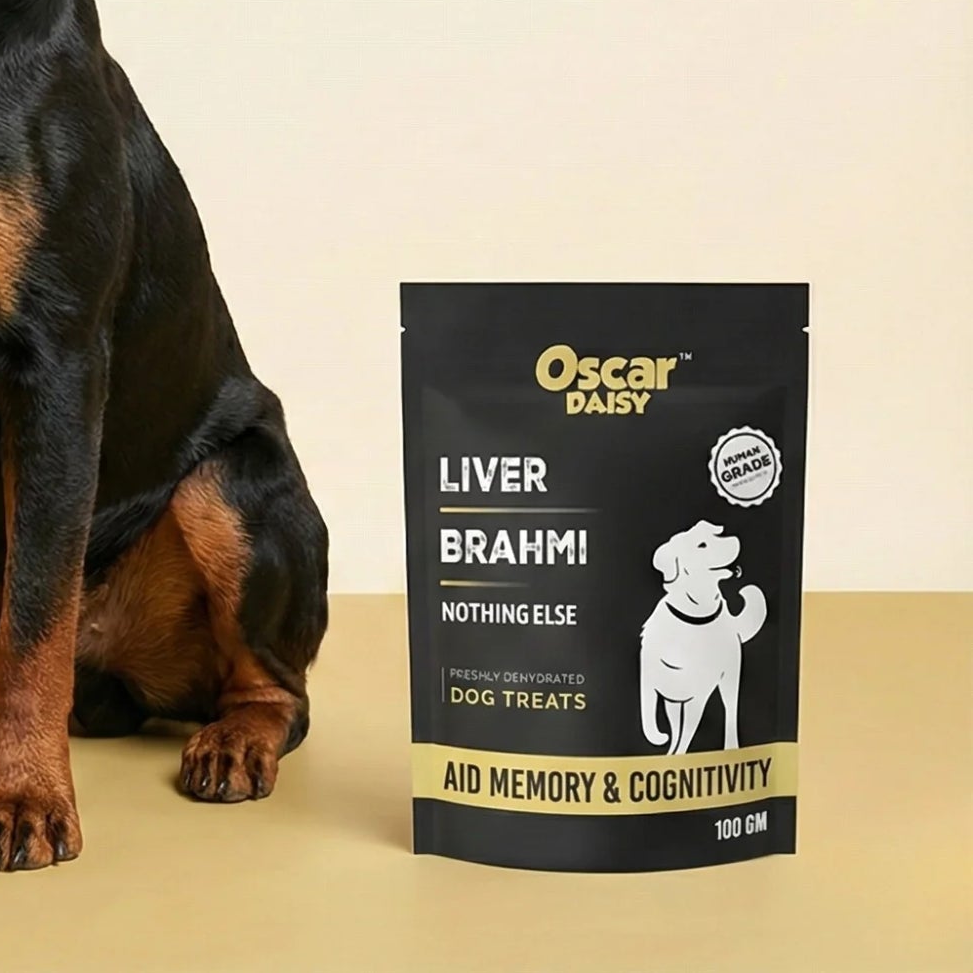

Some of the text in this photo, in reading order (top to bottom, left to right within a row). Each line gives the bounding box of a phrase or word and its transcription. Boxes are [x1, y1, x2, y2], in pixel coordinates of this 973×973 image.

[535, 344, 676, 391] Oscar
[566, 391, 651, 415] DAISY
[439, 457, 548, 493] LIVER
[721, 453, 771, 482] GRADE
[439, 529, 587, 565] BRAHMI
[442, 601, 577, 625] NOTHING ELSE
[451, 687, 586, 710] DOG TREATS
[443, 757, 772, 804] AID MEMORY & COGNITIVITY
[714, 811, 768, 841] 100 GM
